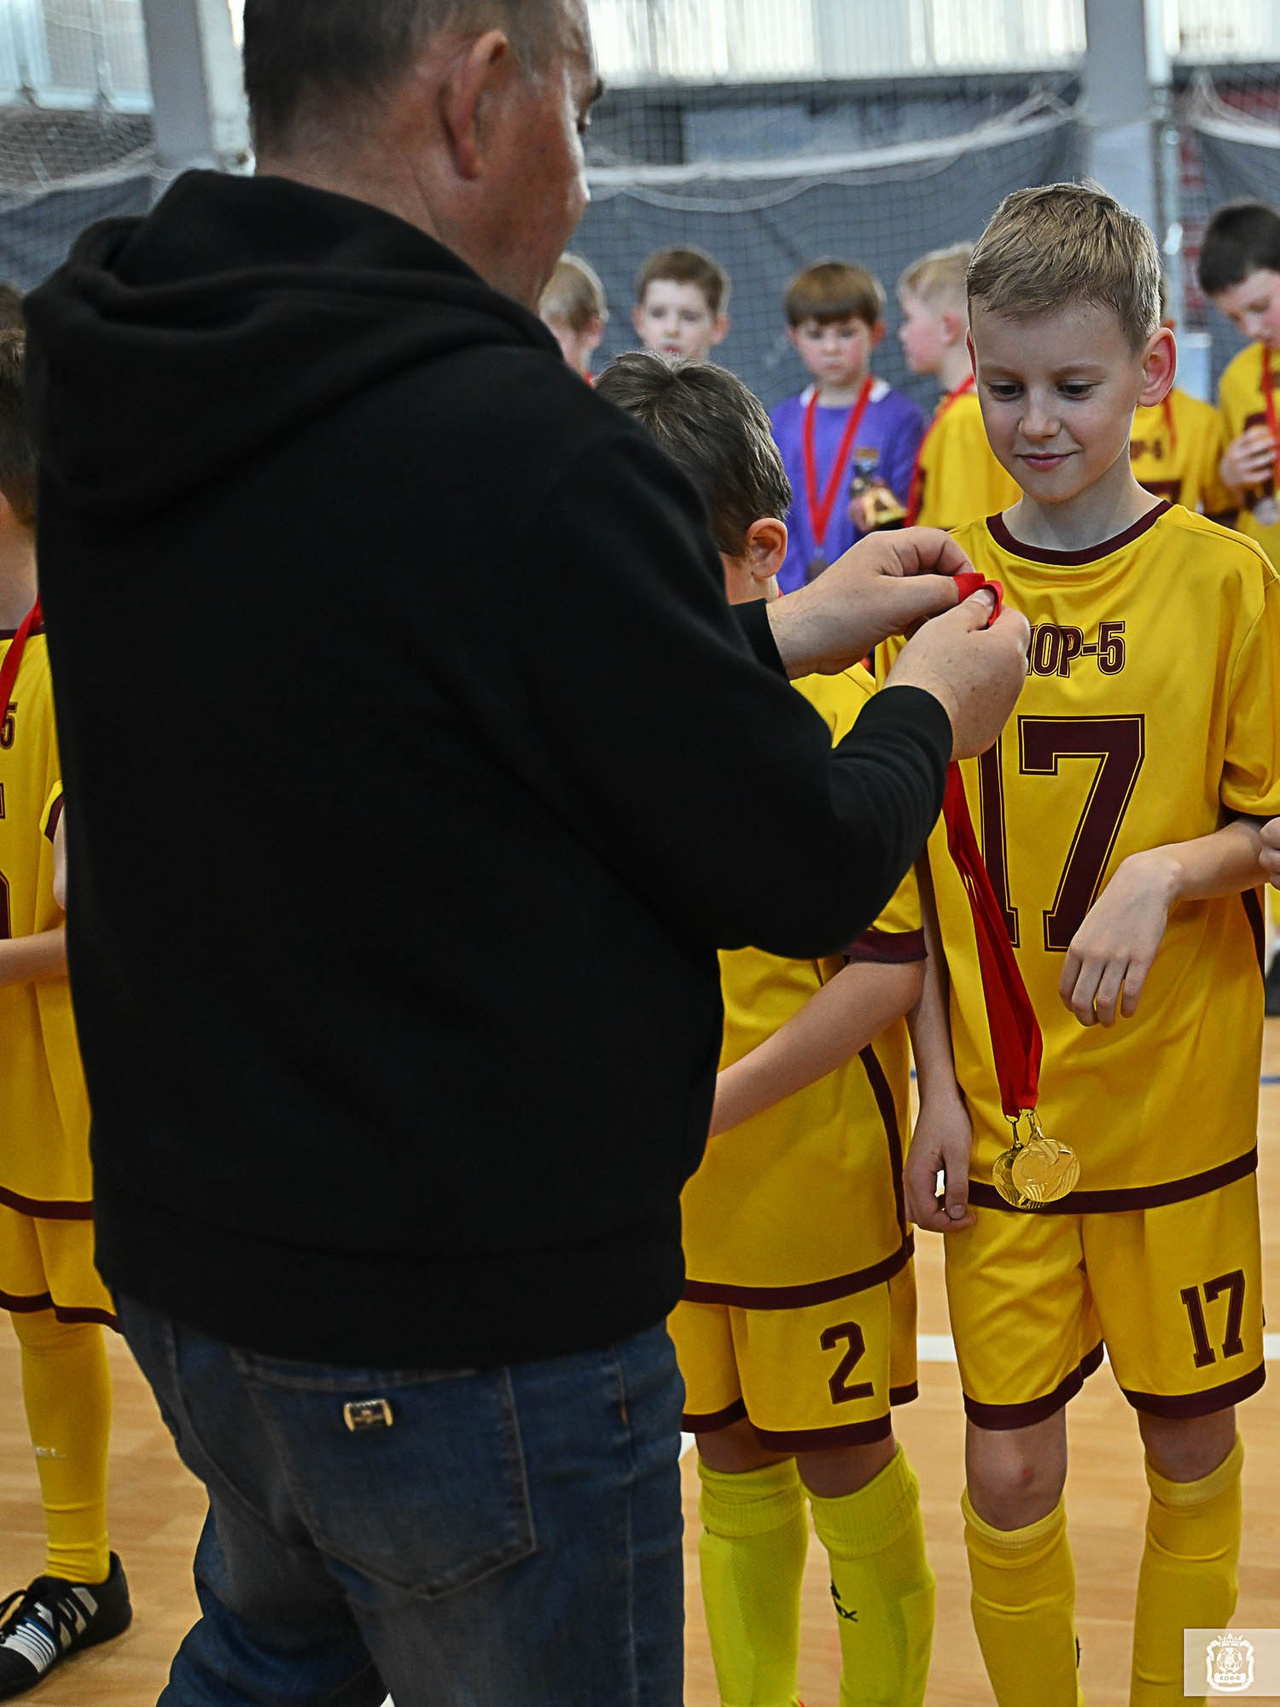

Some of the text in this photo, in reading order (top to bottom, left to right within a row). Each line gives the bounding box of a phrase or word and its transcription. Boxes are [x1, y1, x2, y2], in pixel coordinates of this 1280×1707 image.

[1026, 620, 1126, 678] ОР-5
[977, 714, 1145, 952] 17
[819, 1321, 875, 1405] 2
[1180, 1269, 1247, 1368] 17
